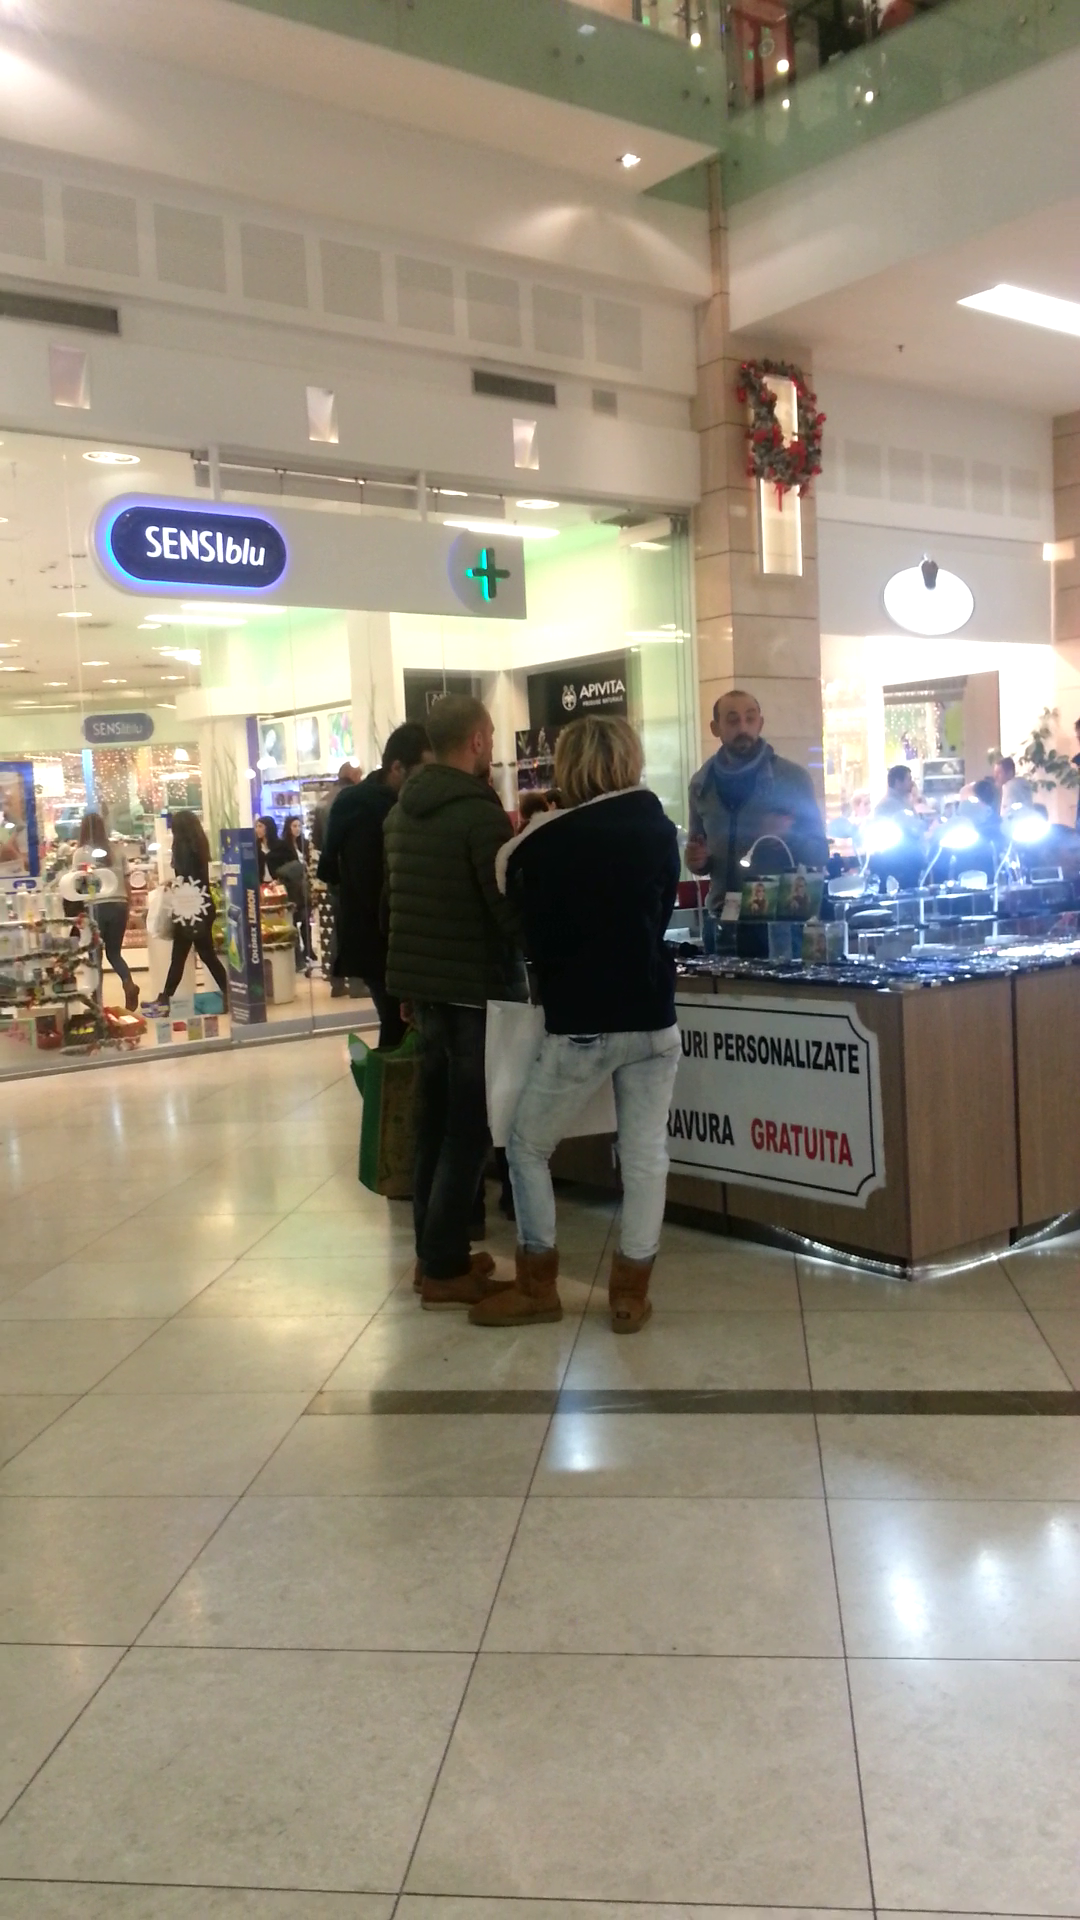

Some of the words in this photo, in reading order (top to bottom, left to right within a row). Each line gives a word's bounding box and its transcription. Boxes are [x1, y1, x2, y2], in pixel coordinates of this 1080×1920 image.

[145, 525, 266, 567] SENSIblu
[579, 679, 626, 699] APIVITA
[246, 888, 257, 924] LEMON
[714, 1032, 860, 1074] PERSONALIZATE
[750, 1117, 853, 1167] GRATUITA
